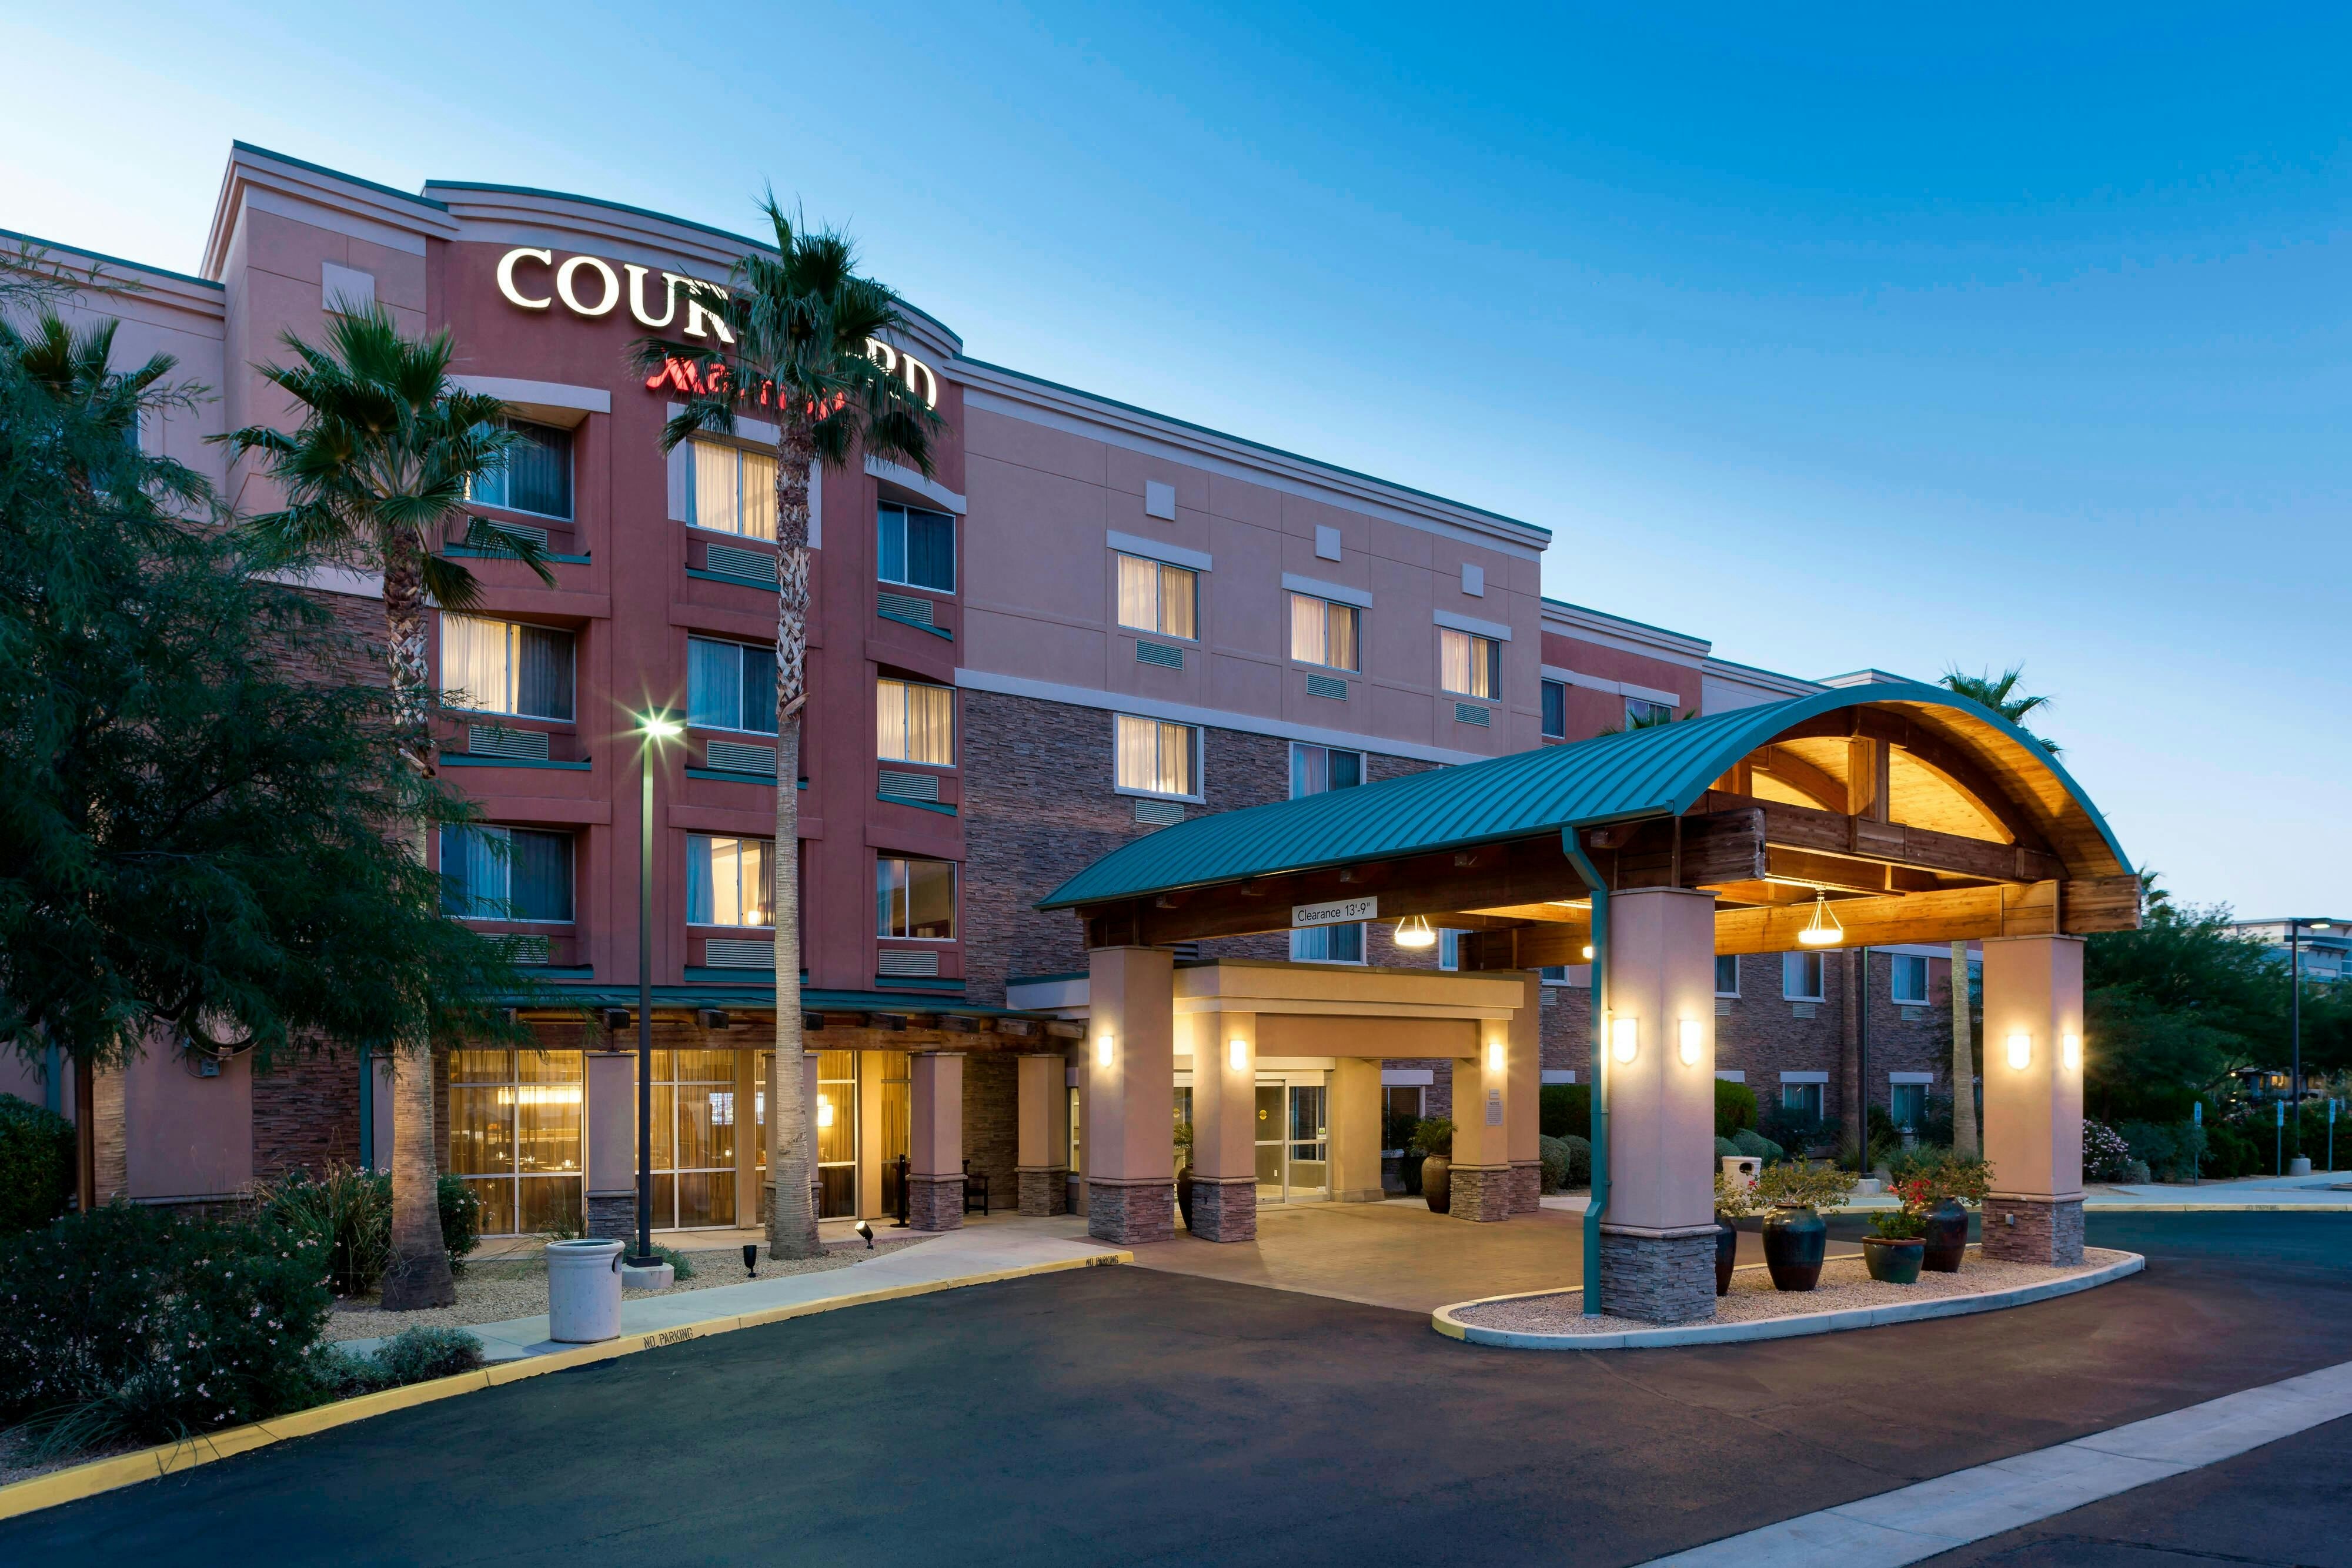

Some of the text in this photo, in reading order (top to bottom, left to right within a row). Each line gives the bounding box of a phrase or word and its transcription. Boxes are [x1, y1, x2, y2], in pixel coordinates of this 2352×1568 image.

[496, 248, 937, 411] COURRD
[1298, 902, 1371, 921] Clearance 13'-9"
[1085, 1255, 1119, 1266] NO PARKING
[643, 1327, 693, 1349] NO PARKING
